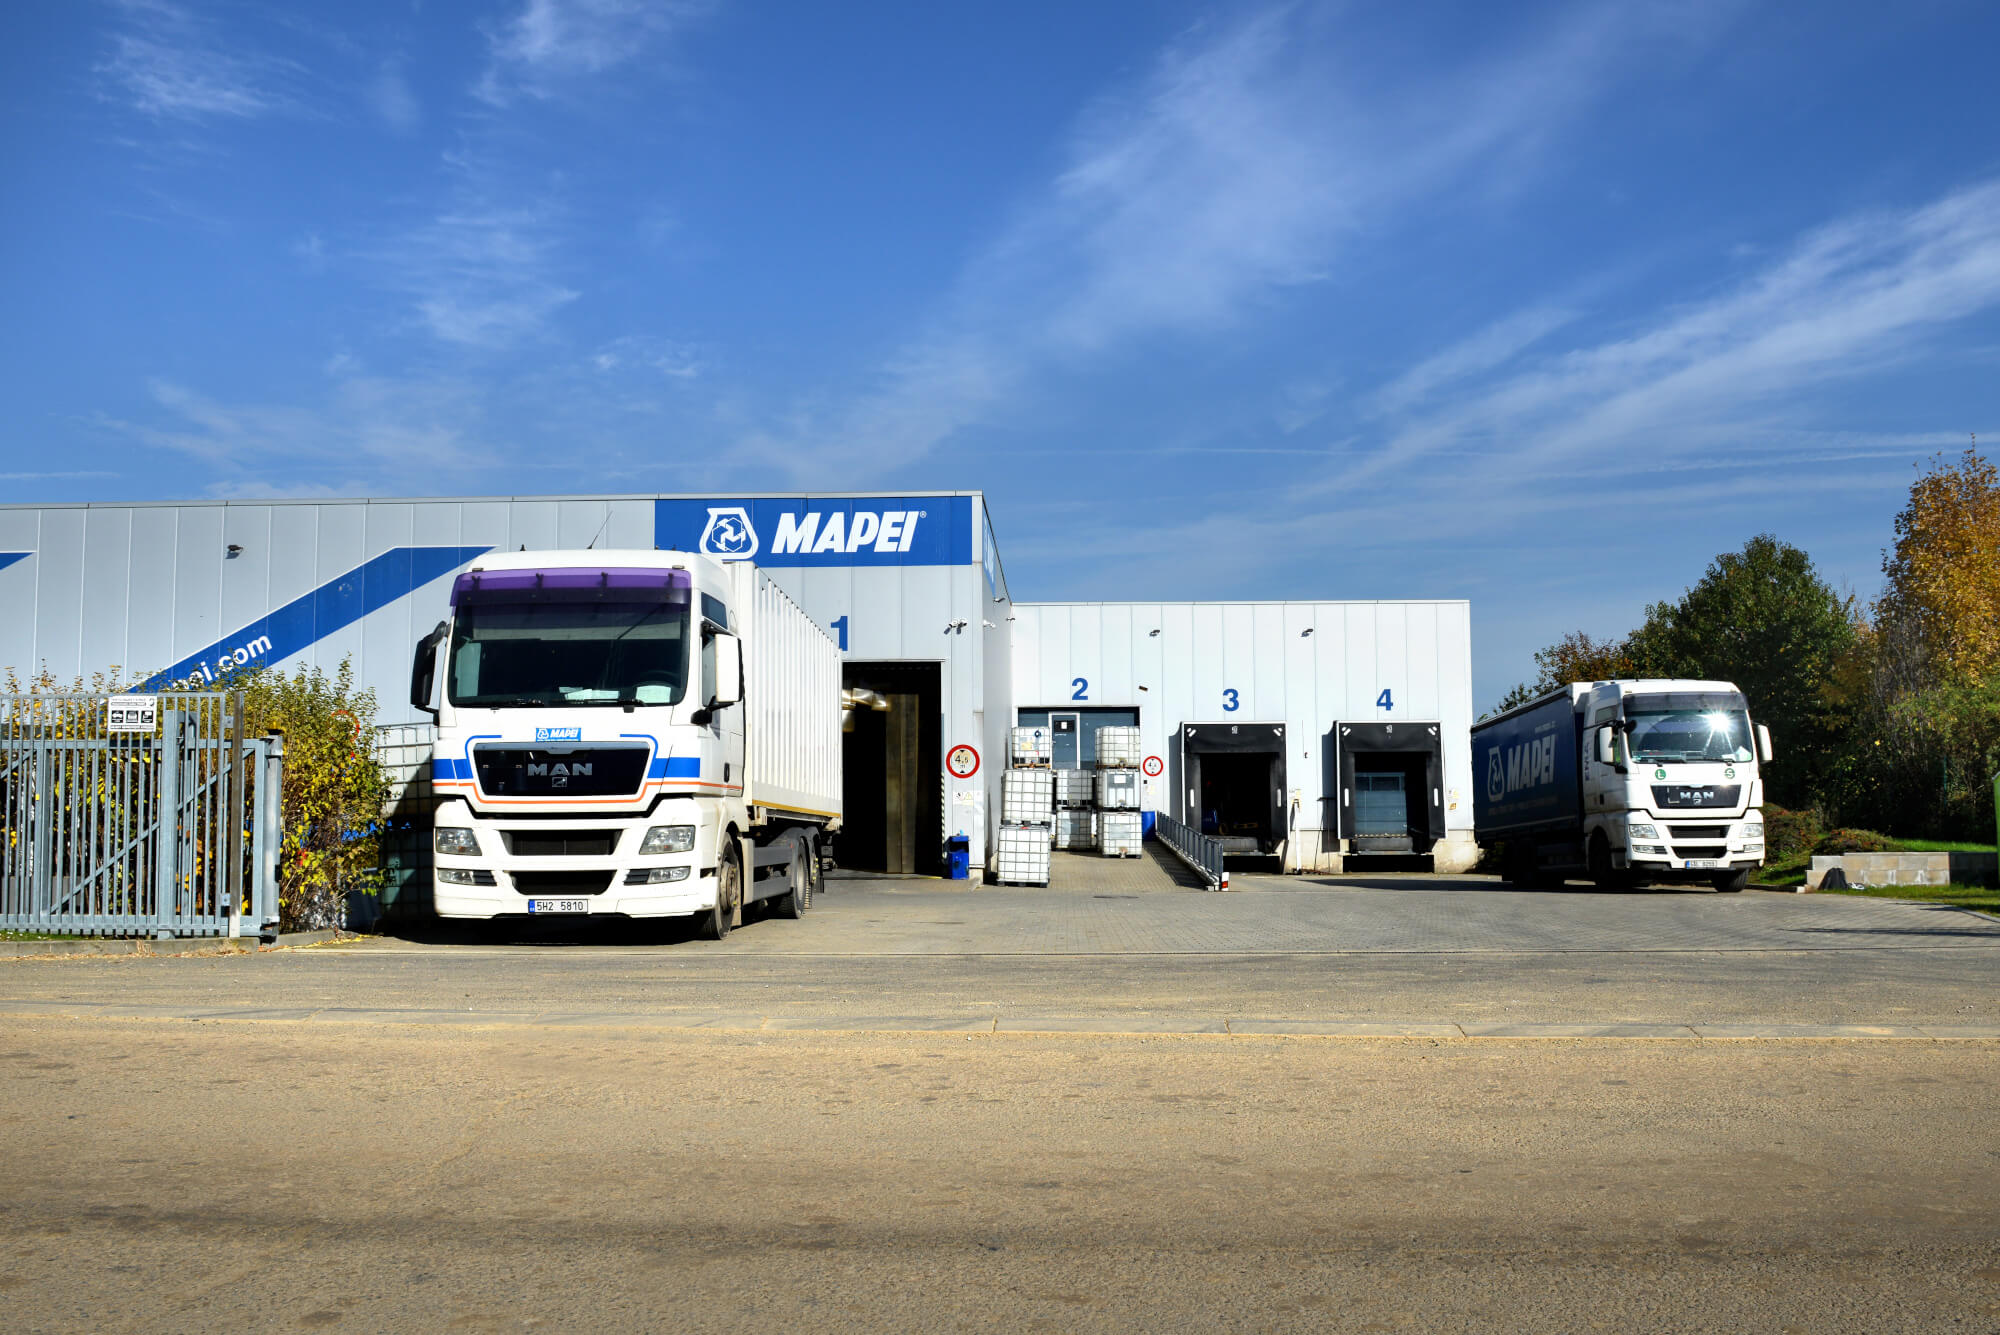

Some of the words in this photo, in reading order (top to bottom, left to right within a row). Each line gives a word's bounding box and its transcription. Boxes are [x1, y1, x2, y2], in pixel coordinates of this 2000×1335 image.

[831, 615, 848, 651] 1
[1071, 677, 1089, 701] 2
[1222, 688, 1240, 712] 3
[1375, 688, 1394, 711] 4
[550, 728, 579, 738] MAPEI
[527, 762, 593, 776] MAN
[1507, 733, 1556, 793] MAPEI
[1679, 791, 1714, 800] MAN
[560, 901, 584, 911] 5810
